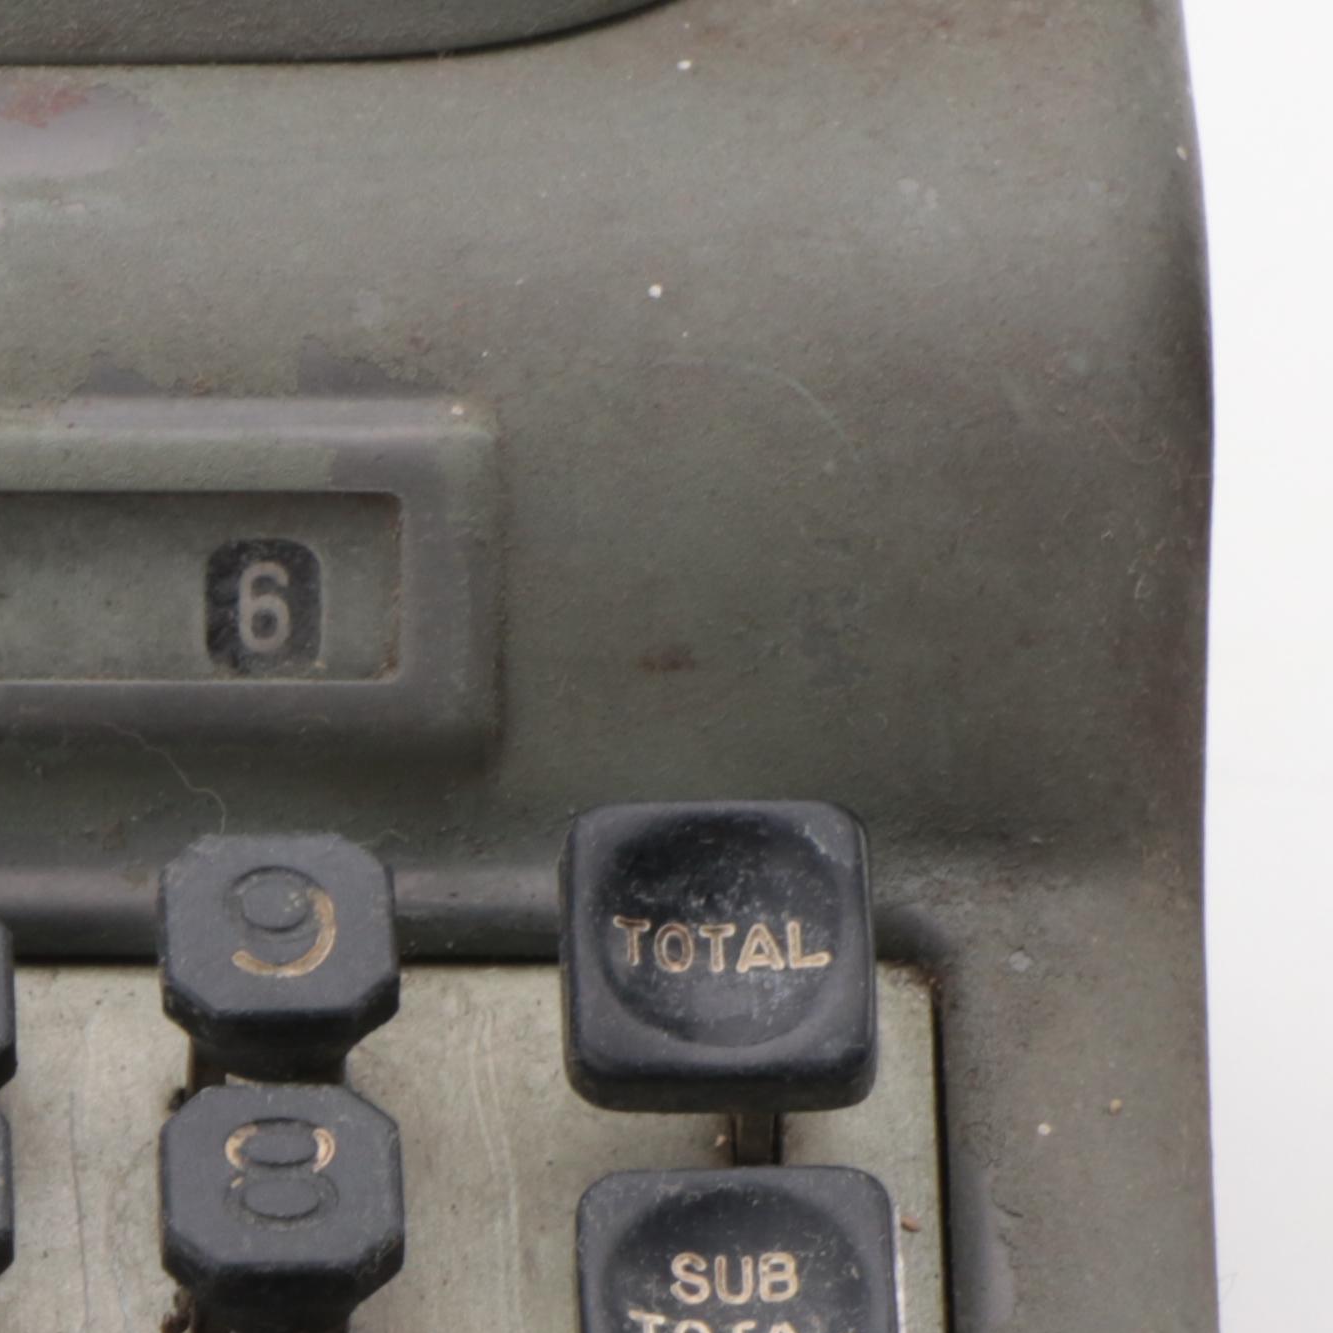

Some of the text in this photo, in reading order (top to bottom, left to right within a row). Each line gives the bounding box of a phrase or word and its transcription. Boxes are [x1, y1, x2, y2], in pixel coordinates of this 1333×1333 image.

[236, 561, 291, 653] 6
[225, 865, 335, 977] 9
[613, 914, 832, 972] TOTAL
[669, 1251, 800, 1305] SUB
